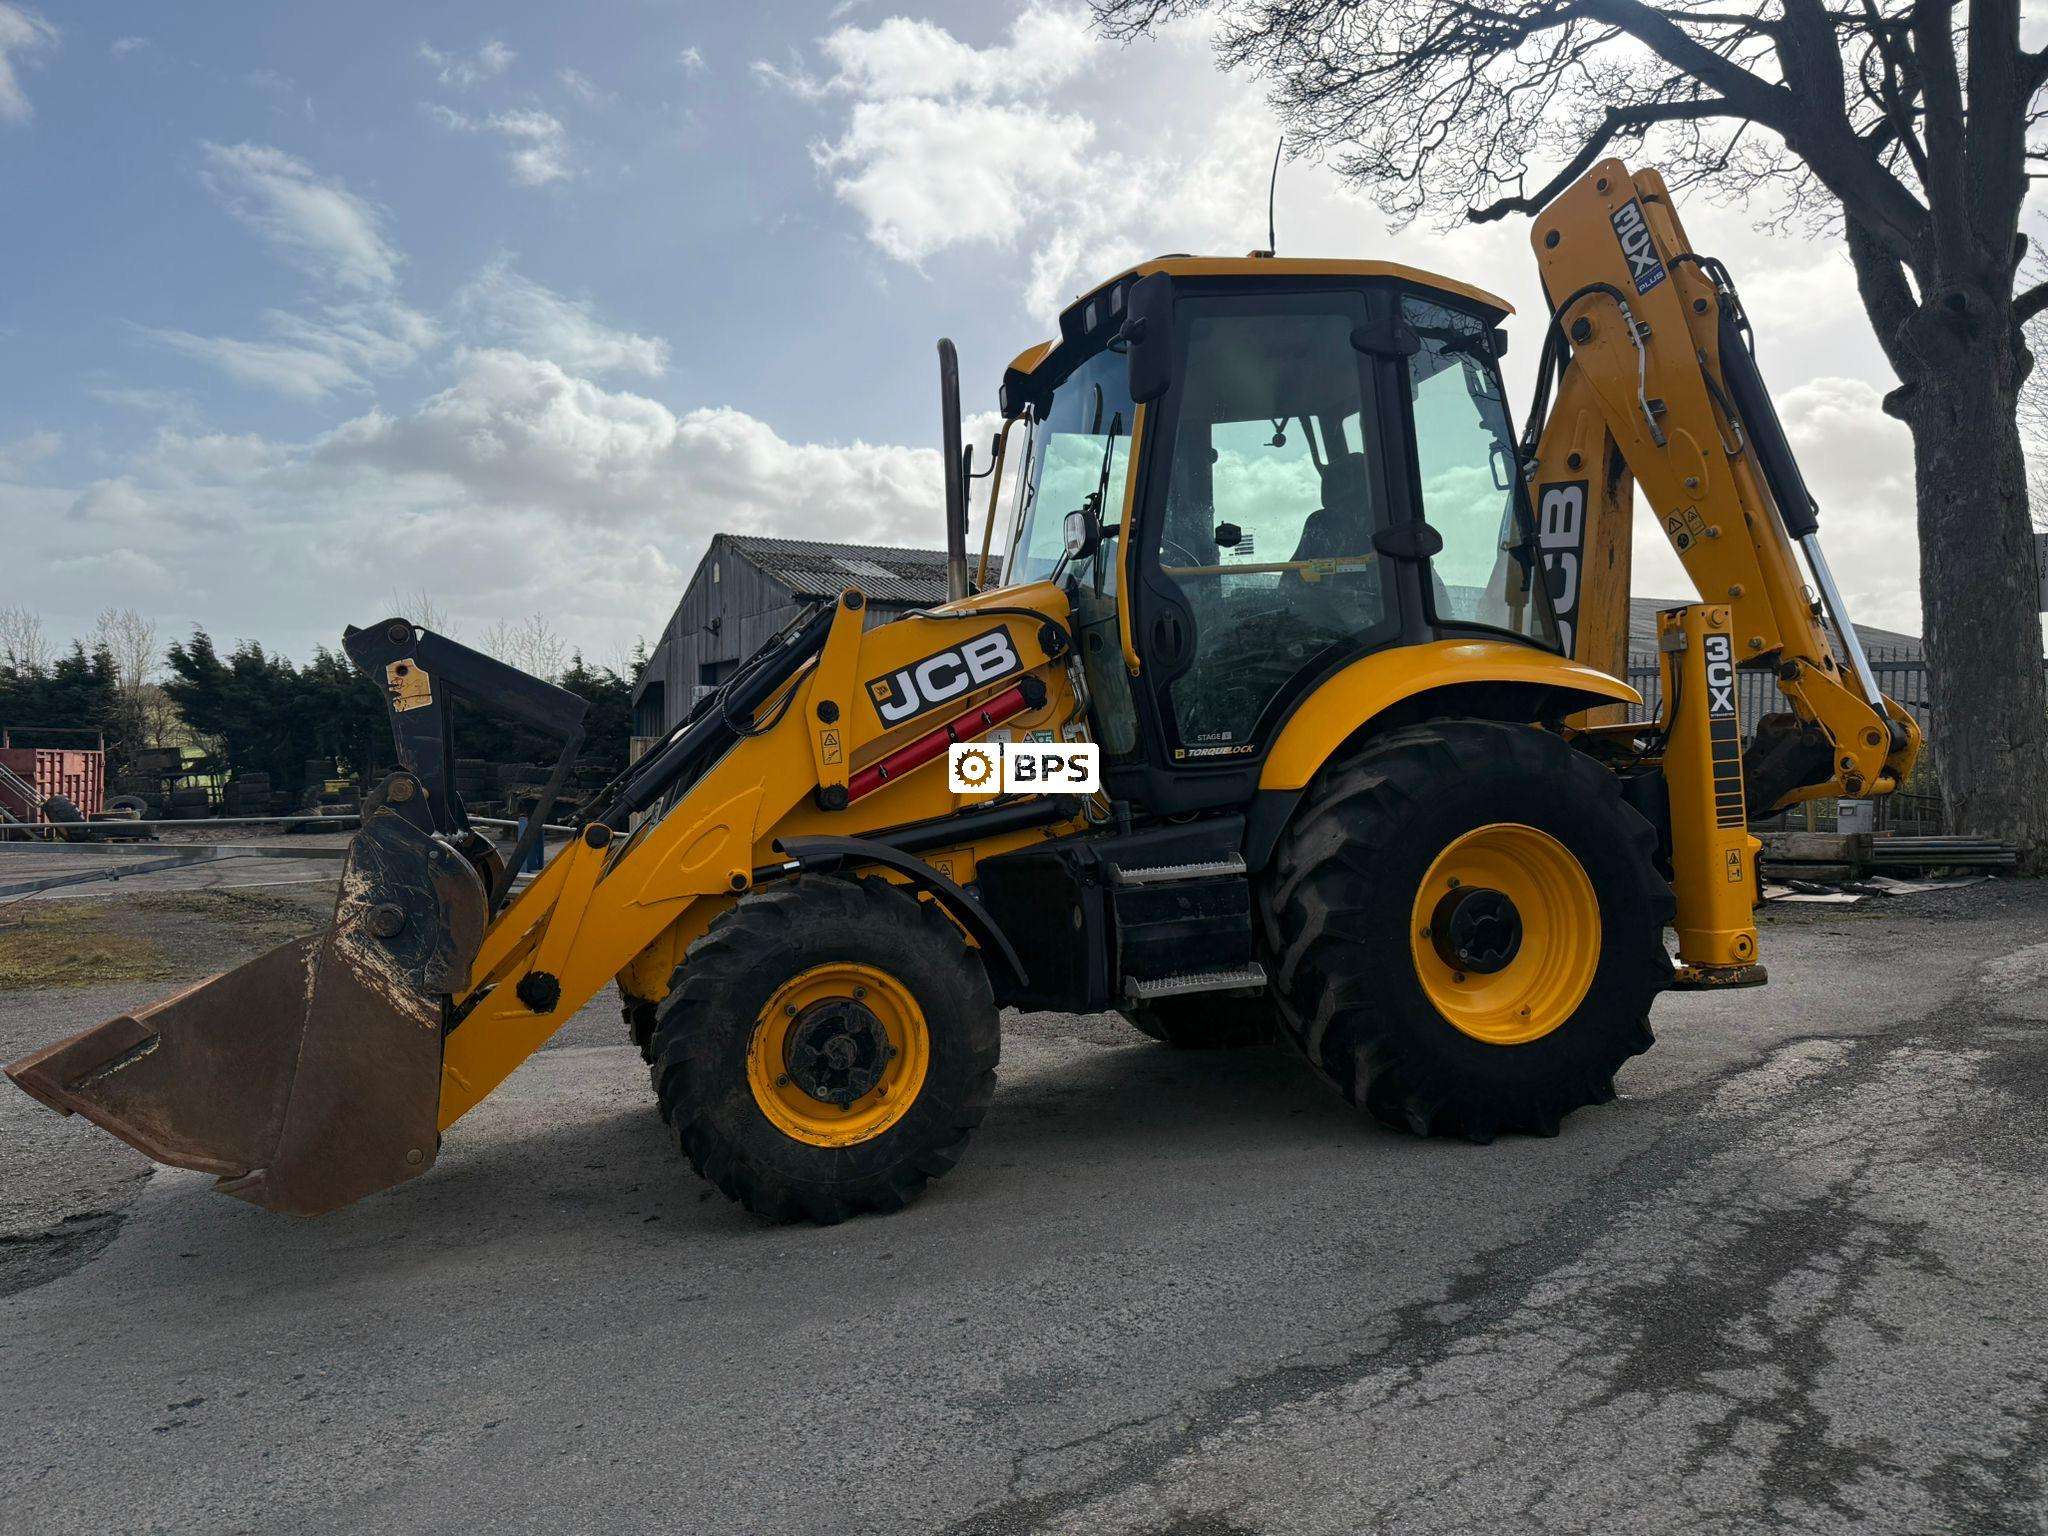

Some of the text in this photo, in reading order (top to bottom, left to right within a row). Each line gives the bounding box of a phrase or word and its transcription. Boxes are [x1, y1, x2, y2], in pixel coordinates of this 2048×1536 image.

[1613, 203, 1658, 279] 3CX
[1639, 271, 1664, 291] PLUS
[880, 632, 1017, 721] JCB
[1706, 636, 1734, 711] 3CX
